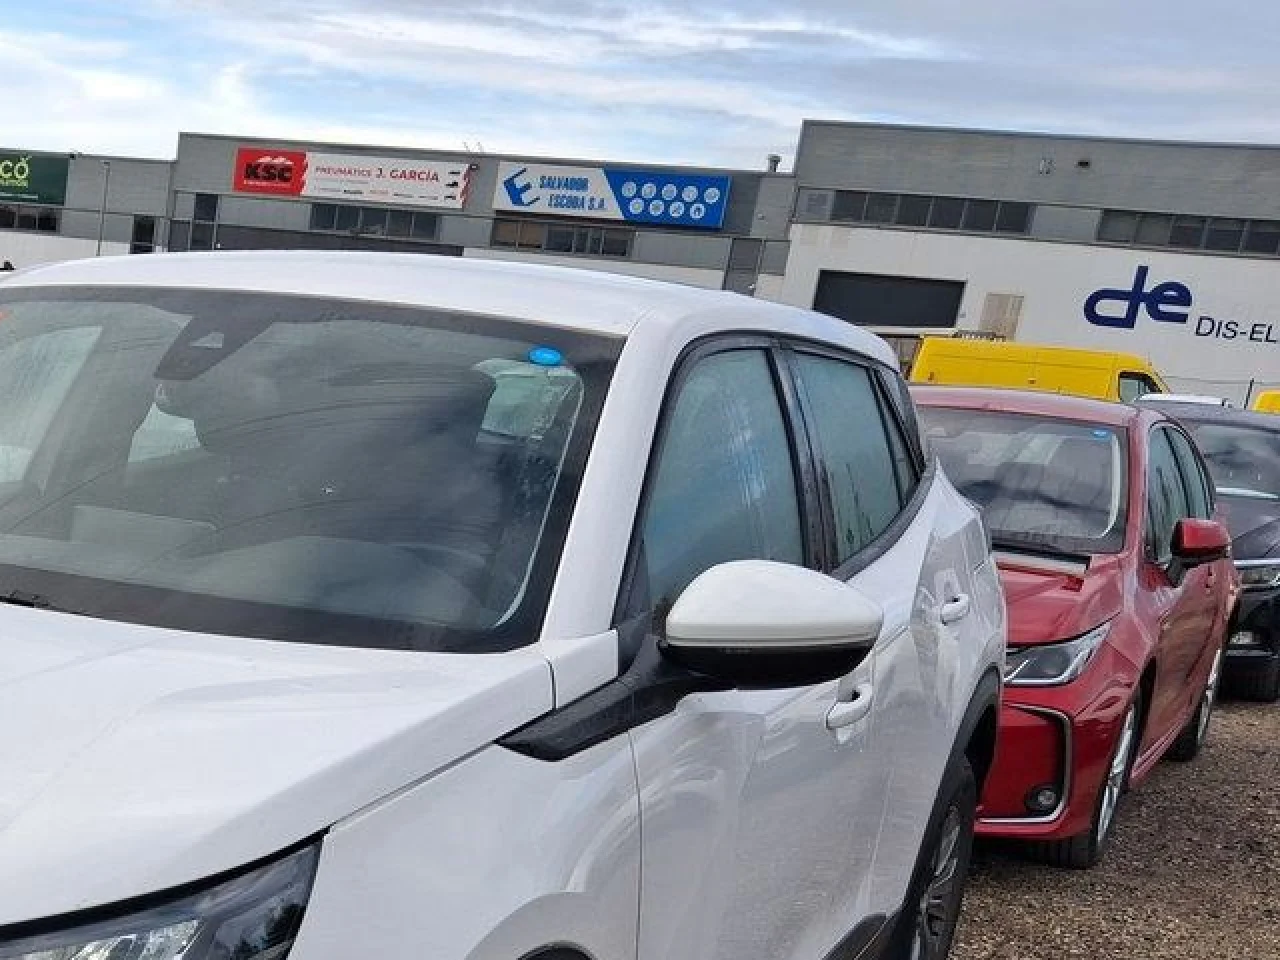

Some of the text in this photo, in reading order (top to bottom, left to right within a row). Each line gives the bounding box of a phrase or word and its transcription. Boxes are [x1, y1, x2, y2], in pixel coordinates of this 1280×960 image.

[245, 163, 292, 182] KSC
[1083, 265, 1192, 328] de
[1195, 315, 1277, 343] DIS-EL
